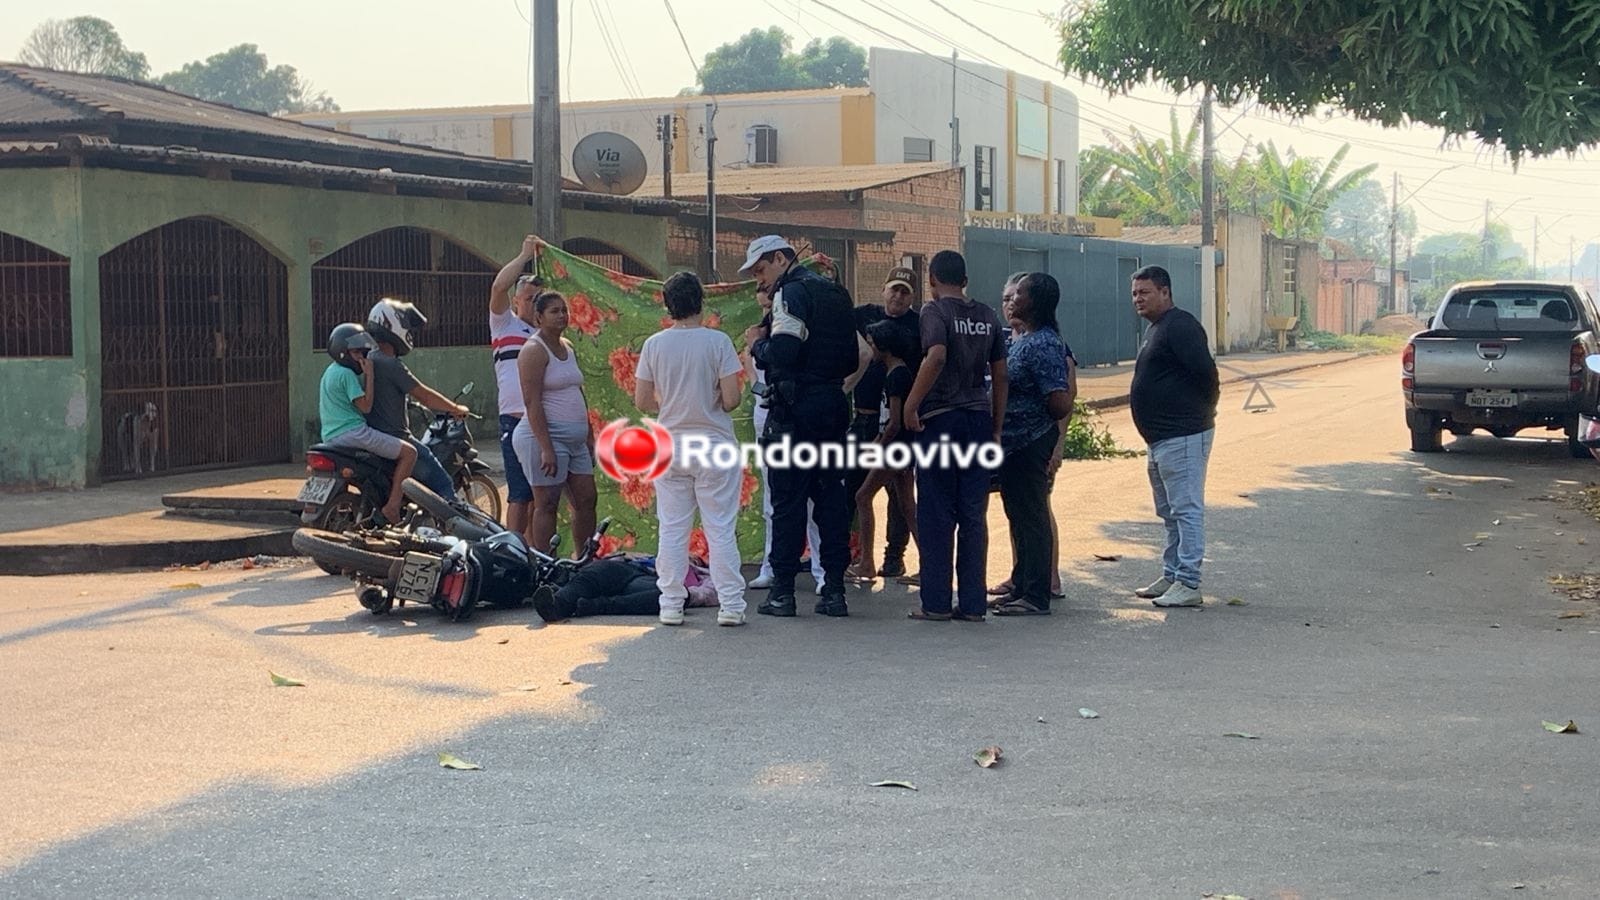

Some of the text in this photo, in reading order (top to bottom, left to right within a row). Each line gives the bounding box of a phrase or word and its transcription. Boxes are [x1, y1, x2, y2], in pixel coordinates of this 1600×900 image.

[596, 147, 620, 162] Via
[954, 317, 992, 336] inter
[1489, 397, 1511, 405] 2547
[400, 562, 419, 595] 1776
[413, 561, 433, 596] NCV
